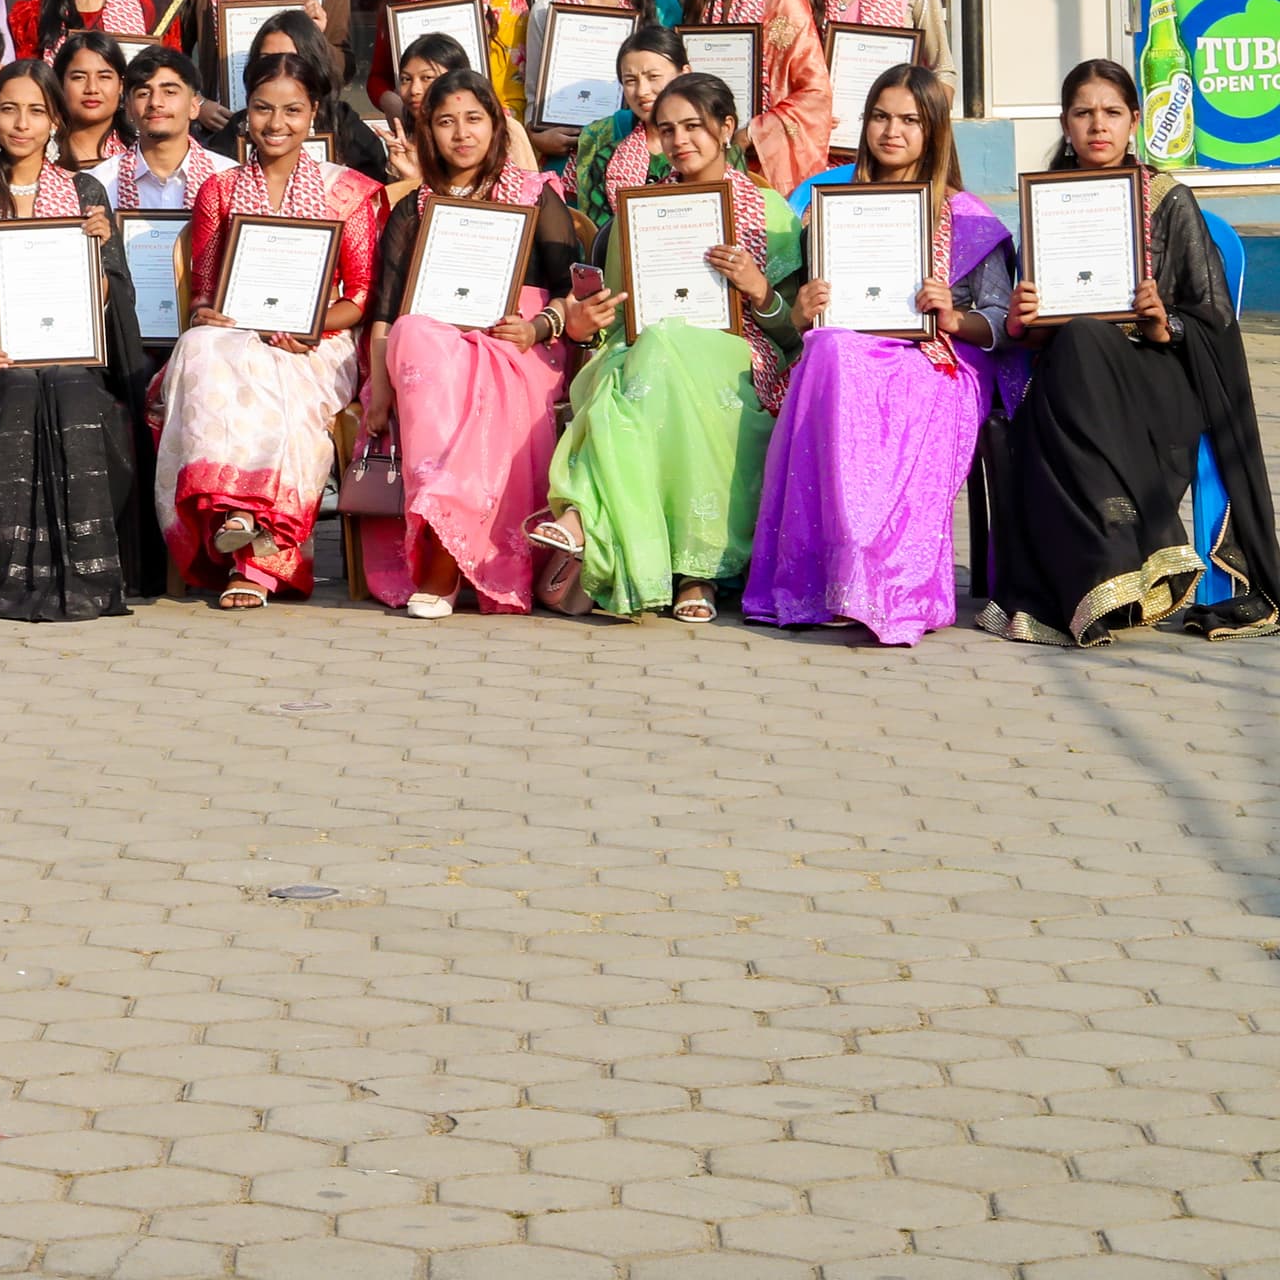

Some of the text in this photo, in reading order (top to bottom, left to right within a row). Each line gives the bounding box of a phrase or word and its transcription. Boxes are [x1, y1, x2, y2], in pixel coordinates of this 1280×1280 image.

[1197, 36, 1280, 75] TUB
[1199, 75, 1258, 94] OPEN
[1150, 92, 1187, 152] TUBORG
